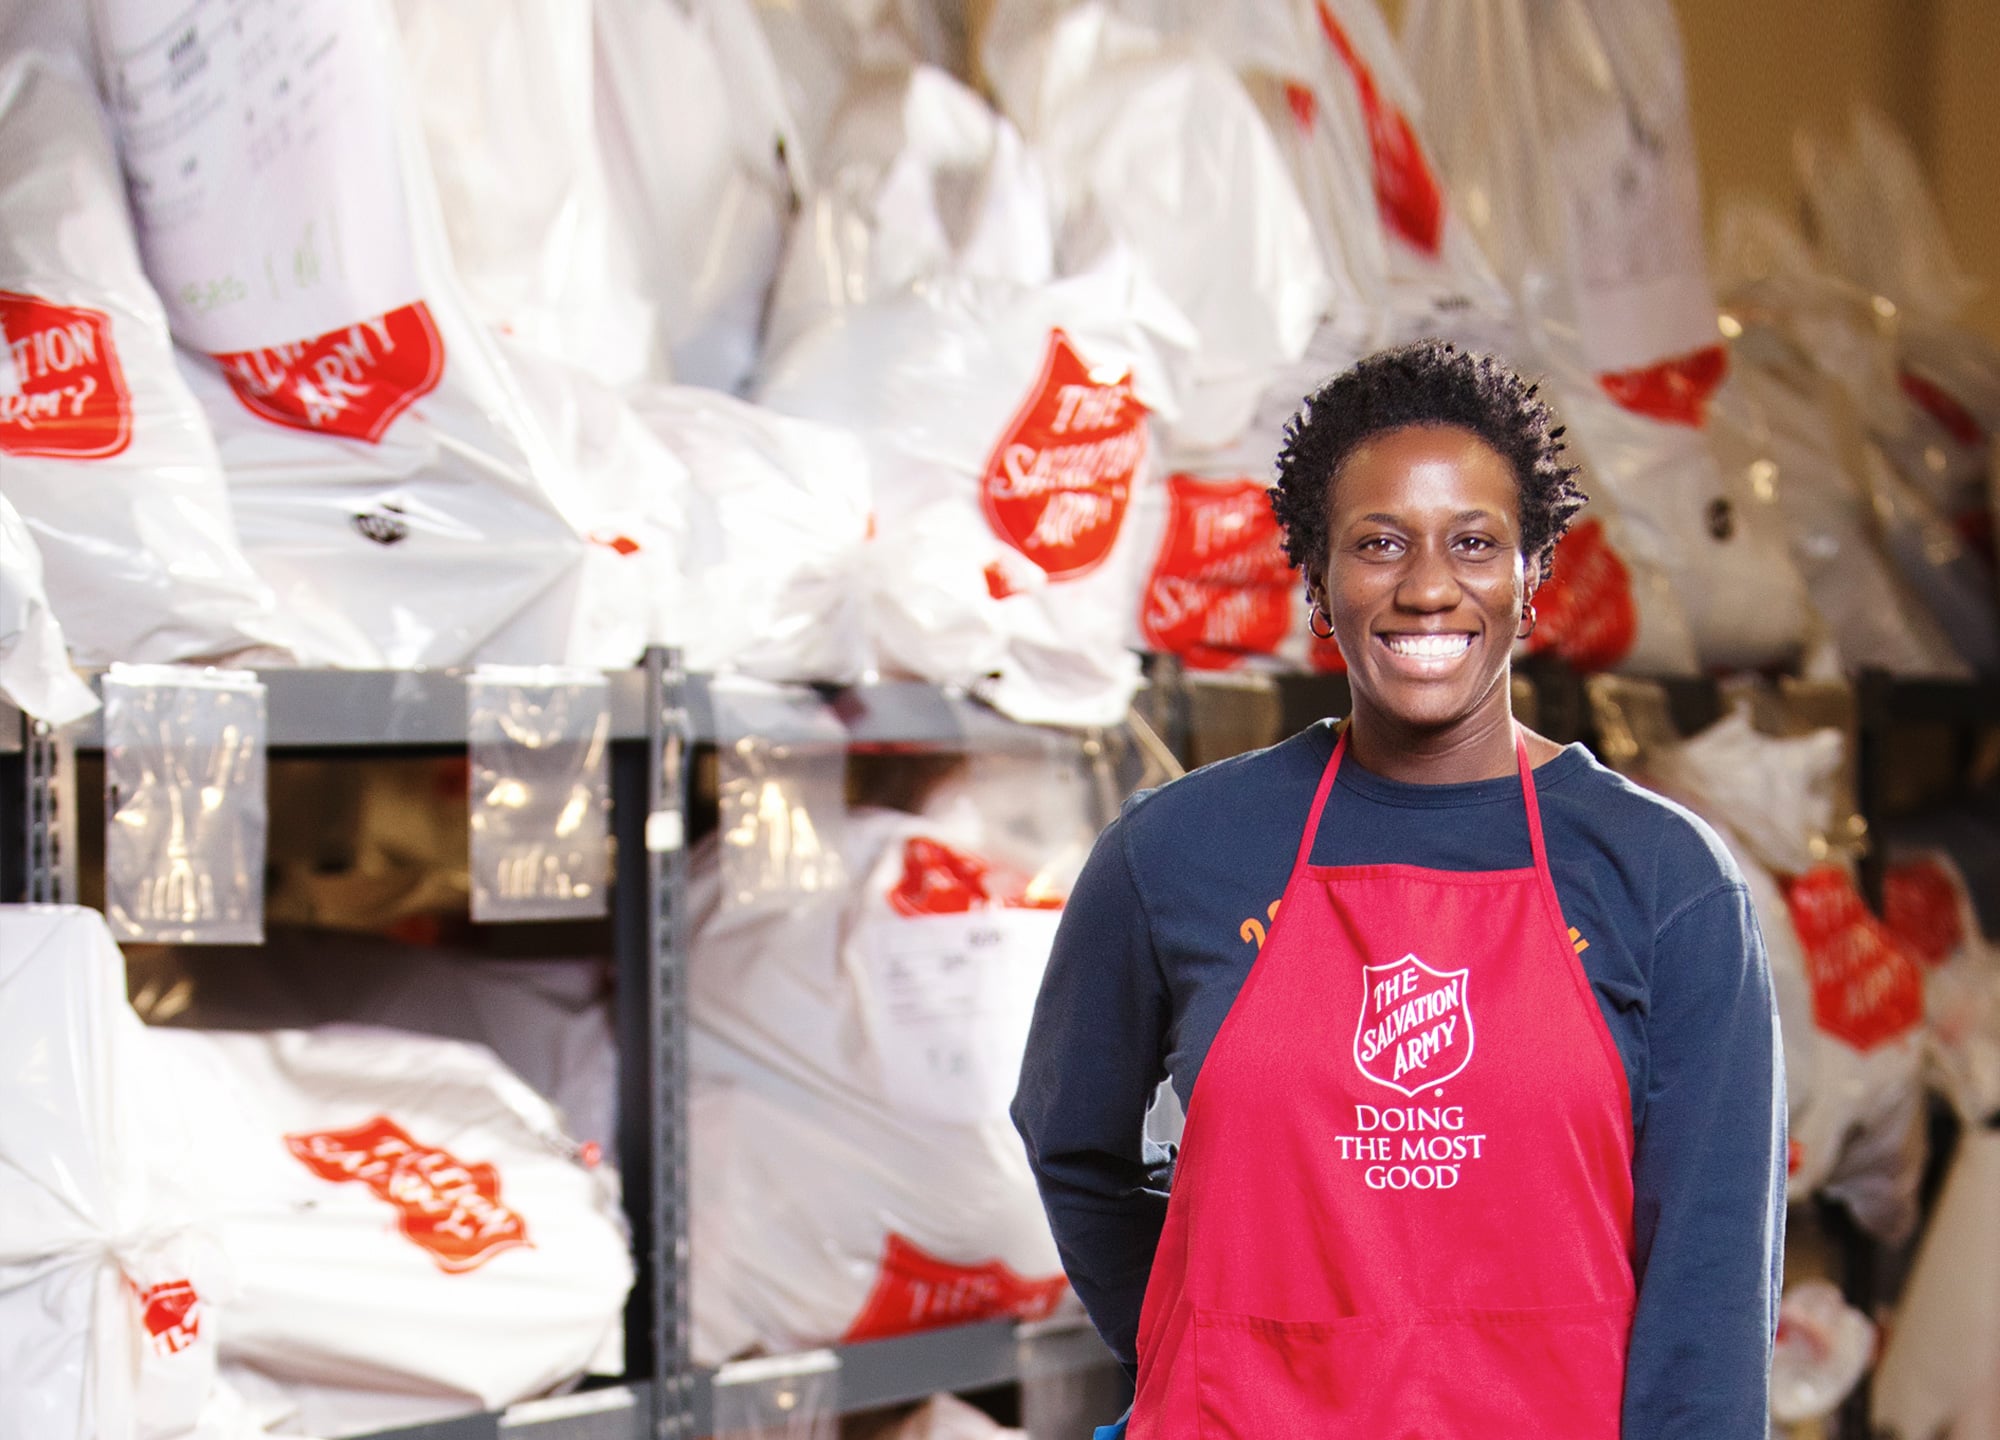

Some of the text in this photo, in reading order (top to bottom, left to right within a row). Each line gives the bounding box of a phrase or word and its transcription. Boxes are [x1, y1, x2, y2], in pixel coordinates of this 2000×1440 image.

[1374, 967, 1420, 1014] THE
[1360, 979, 1459, 1062] SALVATION
[1393, 1015, 1457, 1081] ARMY
[1355, 1105, 1464, 1132] DOING
[1334, 1134, 1486, 1161] THE MOST
[1364, 1165, 1459, 1190] GOOD
